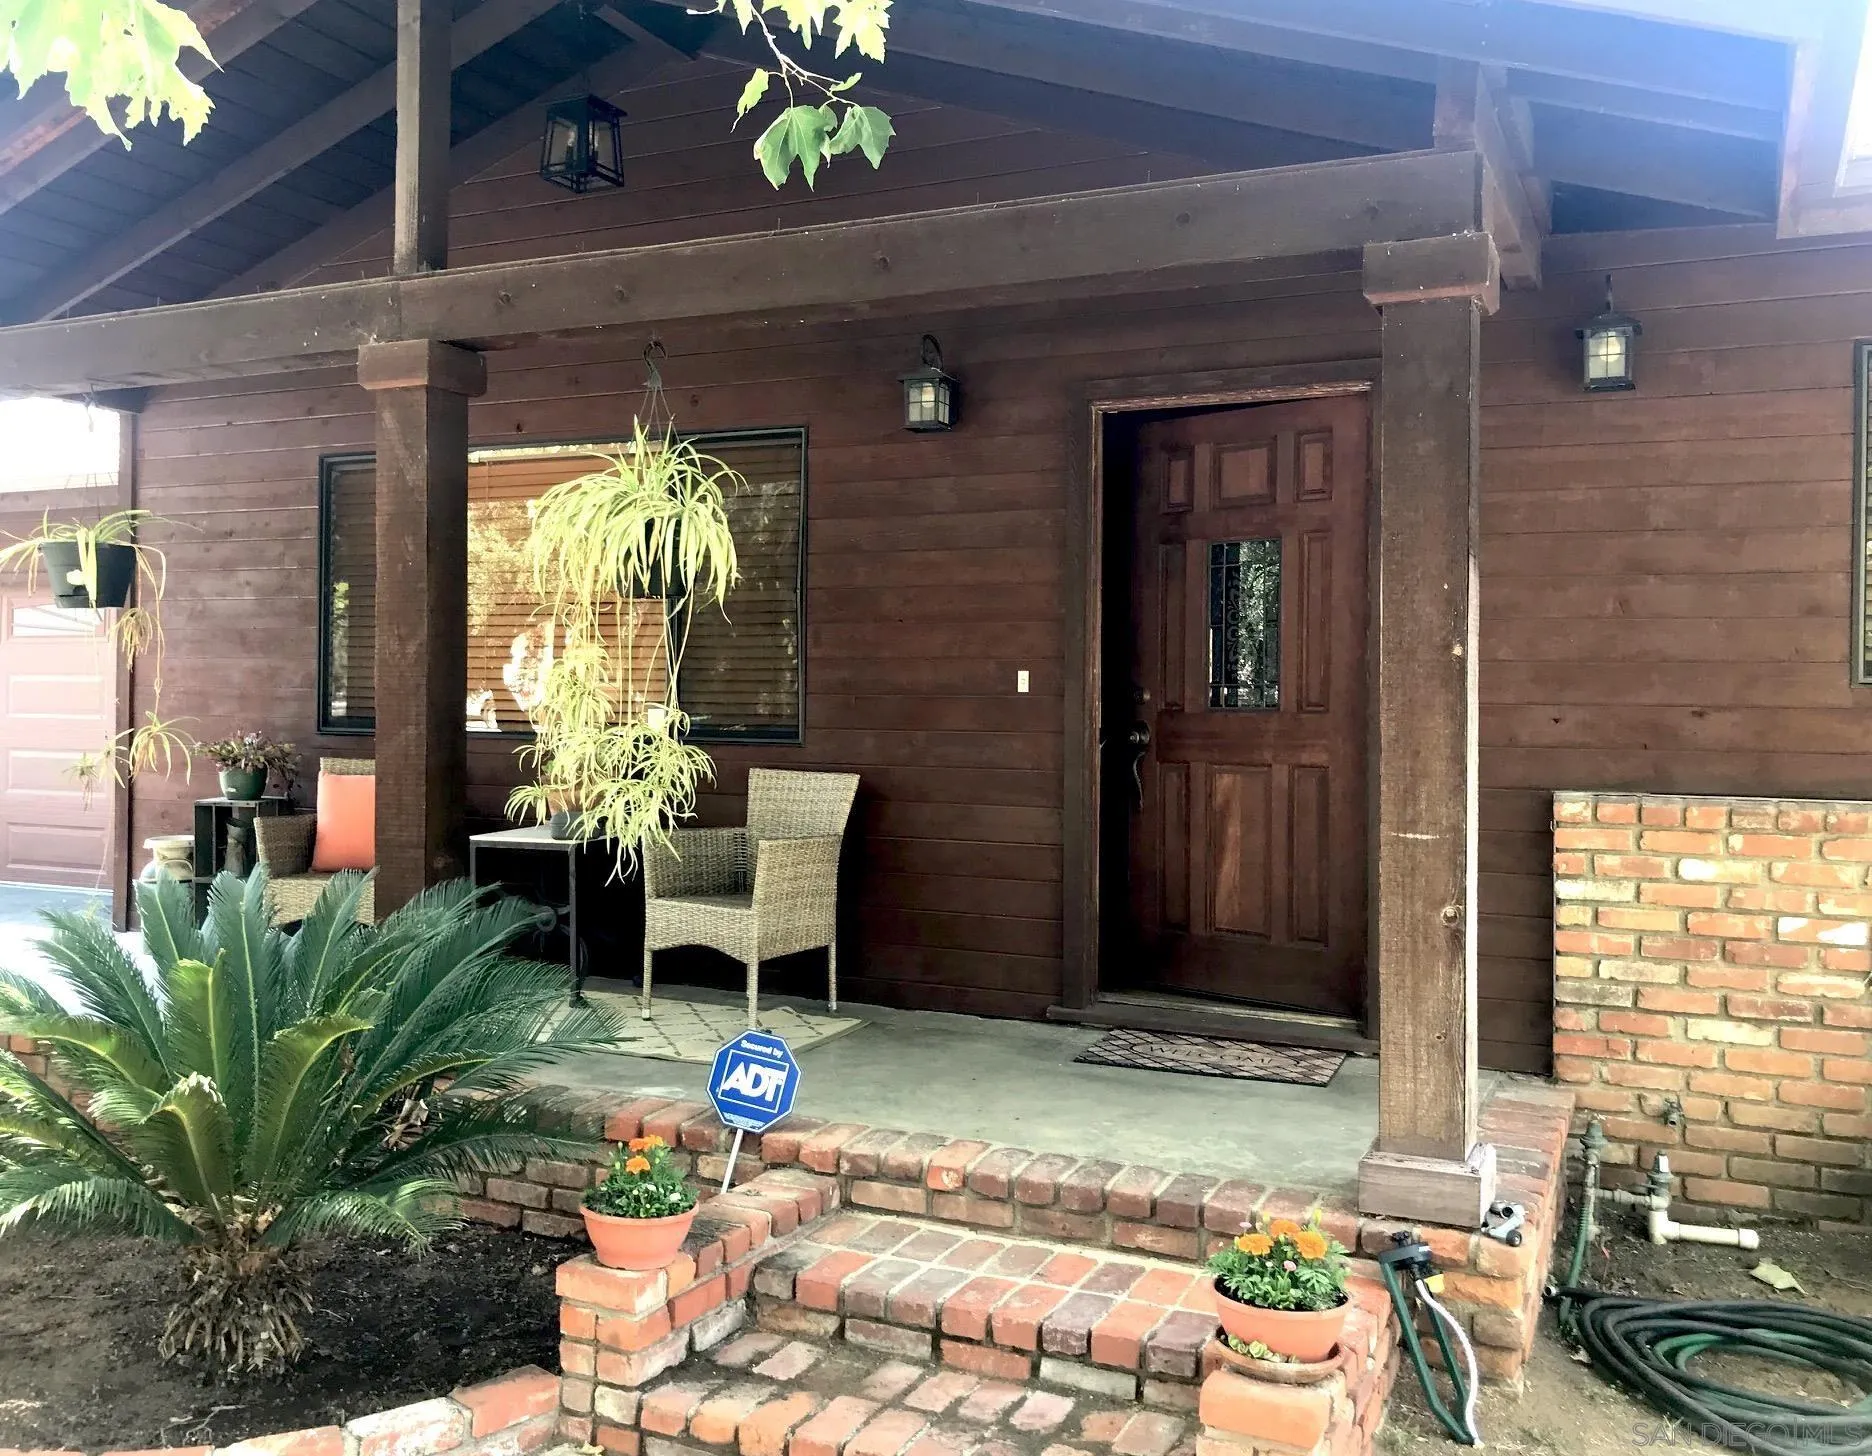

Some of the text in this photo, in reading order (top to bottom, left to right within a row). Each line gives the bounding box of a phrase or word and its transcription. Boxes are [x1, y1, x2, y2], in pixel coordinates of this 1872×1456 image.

[741, 1039, 784, 1059] Secured by
[722, 1061, 787, 1102] ADT
